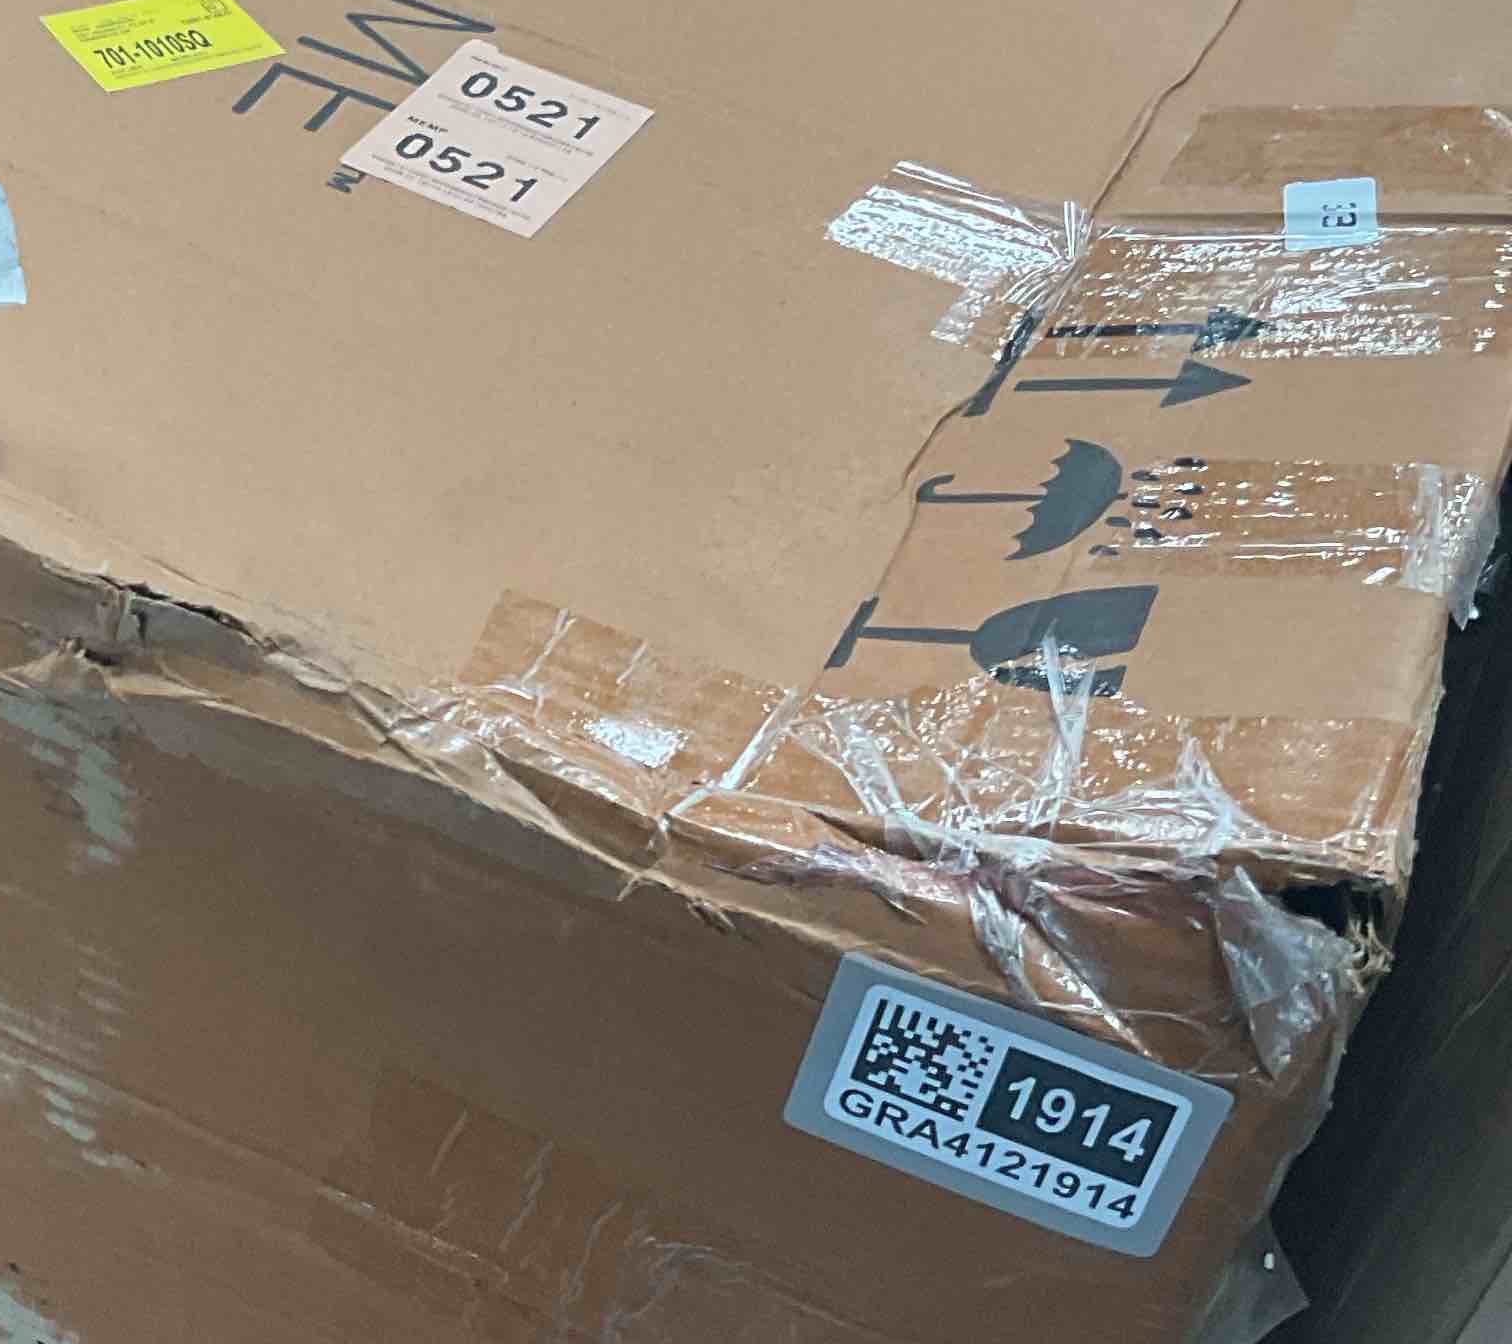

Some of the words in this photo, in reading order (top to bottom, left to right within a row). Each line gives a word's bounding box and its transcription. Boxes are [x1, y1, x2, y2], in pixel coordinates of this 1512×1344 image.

[94, 29, 213, 70] 701-1010SQ
[460, 70, 601, 140] 0521
[395, 133, 539, 203] 0521
[838, 1088, 1139, 1220] GRA4121914
[1006, 1074, 1154, 1164] 1914
